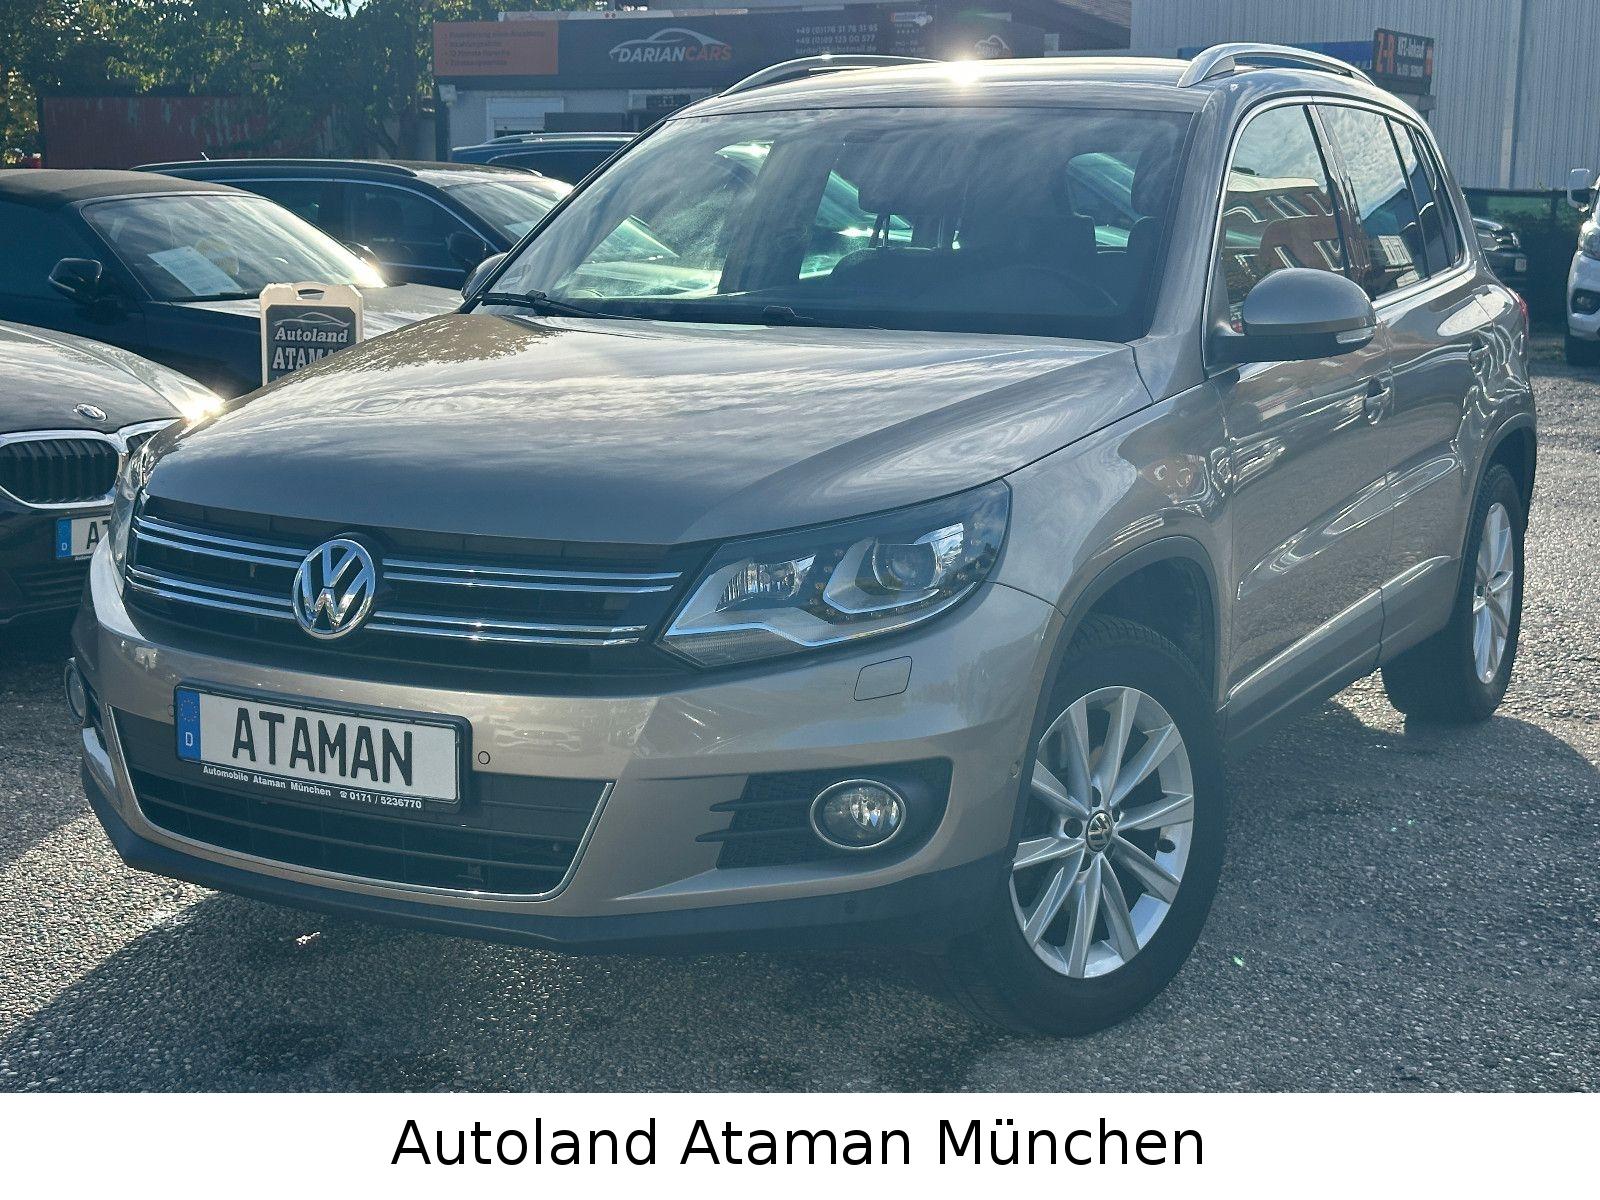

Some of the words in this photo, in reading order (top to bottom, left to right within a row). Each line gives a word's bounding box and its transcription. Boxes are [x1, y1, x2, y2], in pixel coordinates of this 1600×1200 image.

[618, 46, 732, 63] DARIANCARS
[274, 326, 349, 343] Autoland
[272, 346, 335, 370] ATAM
[61, 542, 68, 551] D
[185, 731, 194, 748] D
[231, 707, 413, 787] ATAMAN
[202, 765, 249, 783] Automobile
[253, 776, 286, 790] Ataman
[290, 782, 332, 797] München
[349, 790, 372, 804] 0171
[380, 795, 422, 810] 5236770
